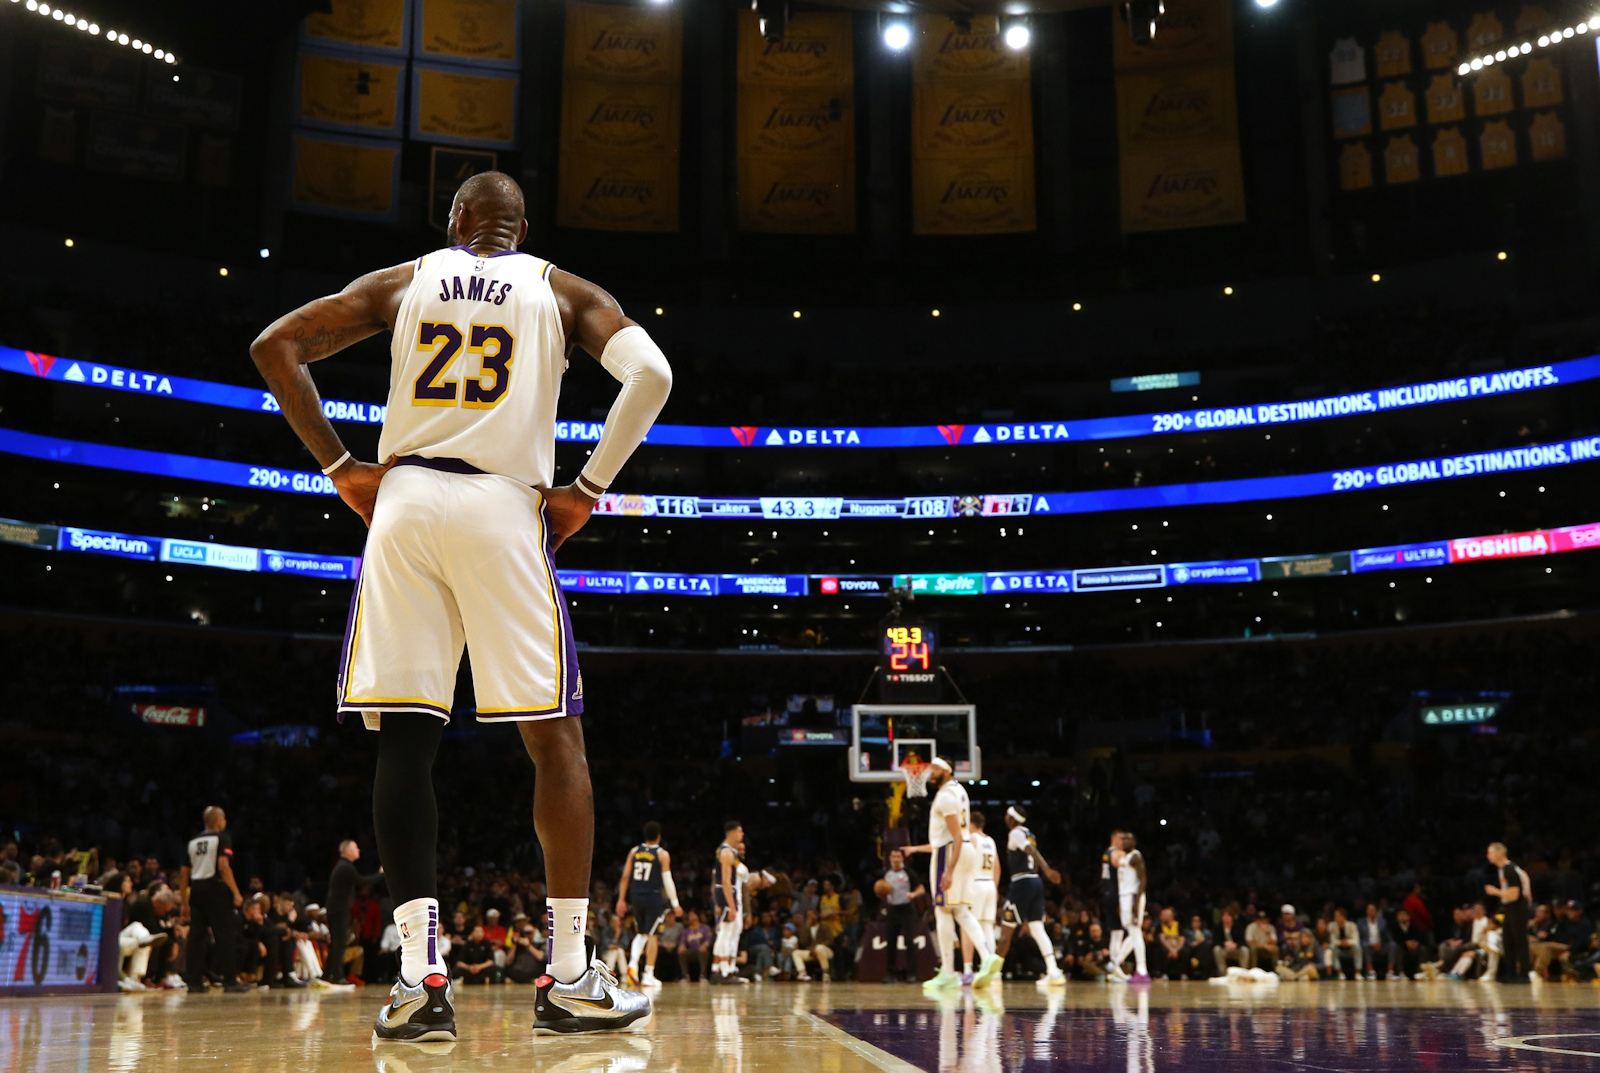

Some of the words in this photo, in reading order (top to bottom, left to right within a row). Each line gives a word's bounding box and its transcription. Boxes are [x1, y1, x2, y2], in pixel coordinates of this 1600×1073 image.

[939, 103, 1006, 127] LAKERS
[941, 180, 1010, 205] LAKERS
[439, 275, 513, 306] JAMES
[411, 320, 517, 410] 23
[91, 366, 173, 394] DELTA
[1152, 414, 1192, 432] 290+
[1195, 407, 1257, 428] GLOBAL
[1258, 391, 1377, 424] DESTINATIONS,
[1378, 377, 1469, 409] INCLUDING
[1470, 365, 1559, 396] PLAYOFFS.
[324, 400, 367, 422] OBAL
[789, 430, 860, 444] DELTA
[996, 424, 1069, 441] DELTA
[1332, 470, 1374, 491] 290+
[1376, 460, 1441, 486] GLOBAL
[1442, 443, 1571, 478] DESTINATIONS,
[1571, 436, 1600, 461] INC
[249, 467, 290, 488] 290+
[292, 473, 338, 495] GLOB
[660, 499, 695, 515] 116
[712, 503, 750, 514] Lakers
[771, 500, 815, 517] 43.3
[850, 503, 897, 515] Nuggets
[911, 499, 946, 514] 108
[70, 530, 149, 555] Spectrum
[1453, 534, 1549, 559] TOSHIBA
[172, 545, 204, 559] UCLA
[211, 550, 254, 566] Health
[1404, 547, 1446, 562] ULTRA
[285, 557, 344, 572] crypto.com
[1190, 565, 1249, 579] crypto.com
[585, 576, 624, 587] ULTRA
[653, 577, 711, 591] DELTA
[735, 577, 786, 586] AMERICAN
[742, 585, 787, 594] EXPRESS
[839, 580, 880, 591] TOYOTA
[934, 576, 976, 593] Sprite
[1009, 575, 1068, 589] DELTA
[886, 627, 922, 643] 43.3
[890, 642, 930, 671] 24
[900, 673, 936, 682] TISSOT
[142, 704, 191, 724] Coca-Cola
[633, 861, 653, 882] 27
[981, 853, 994, 872] 15
